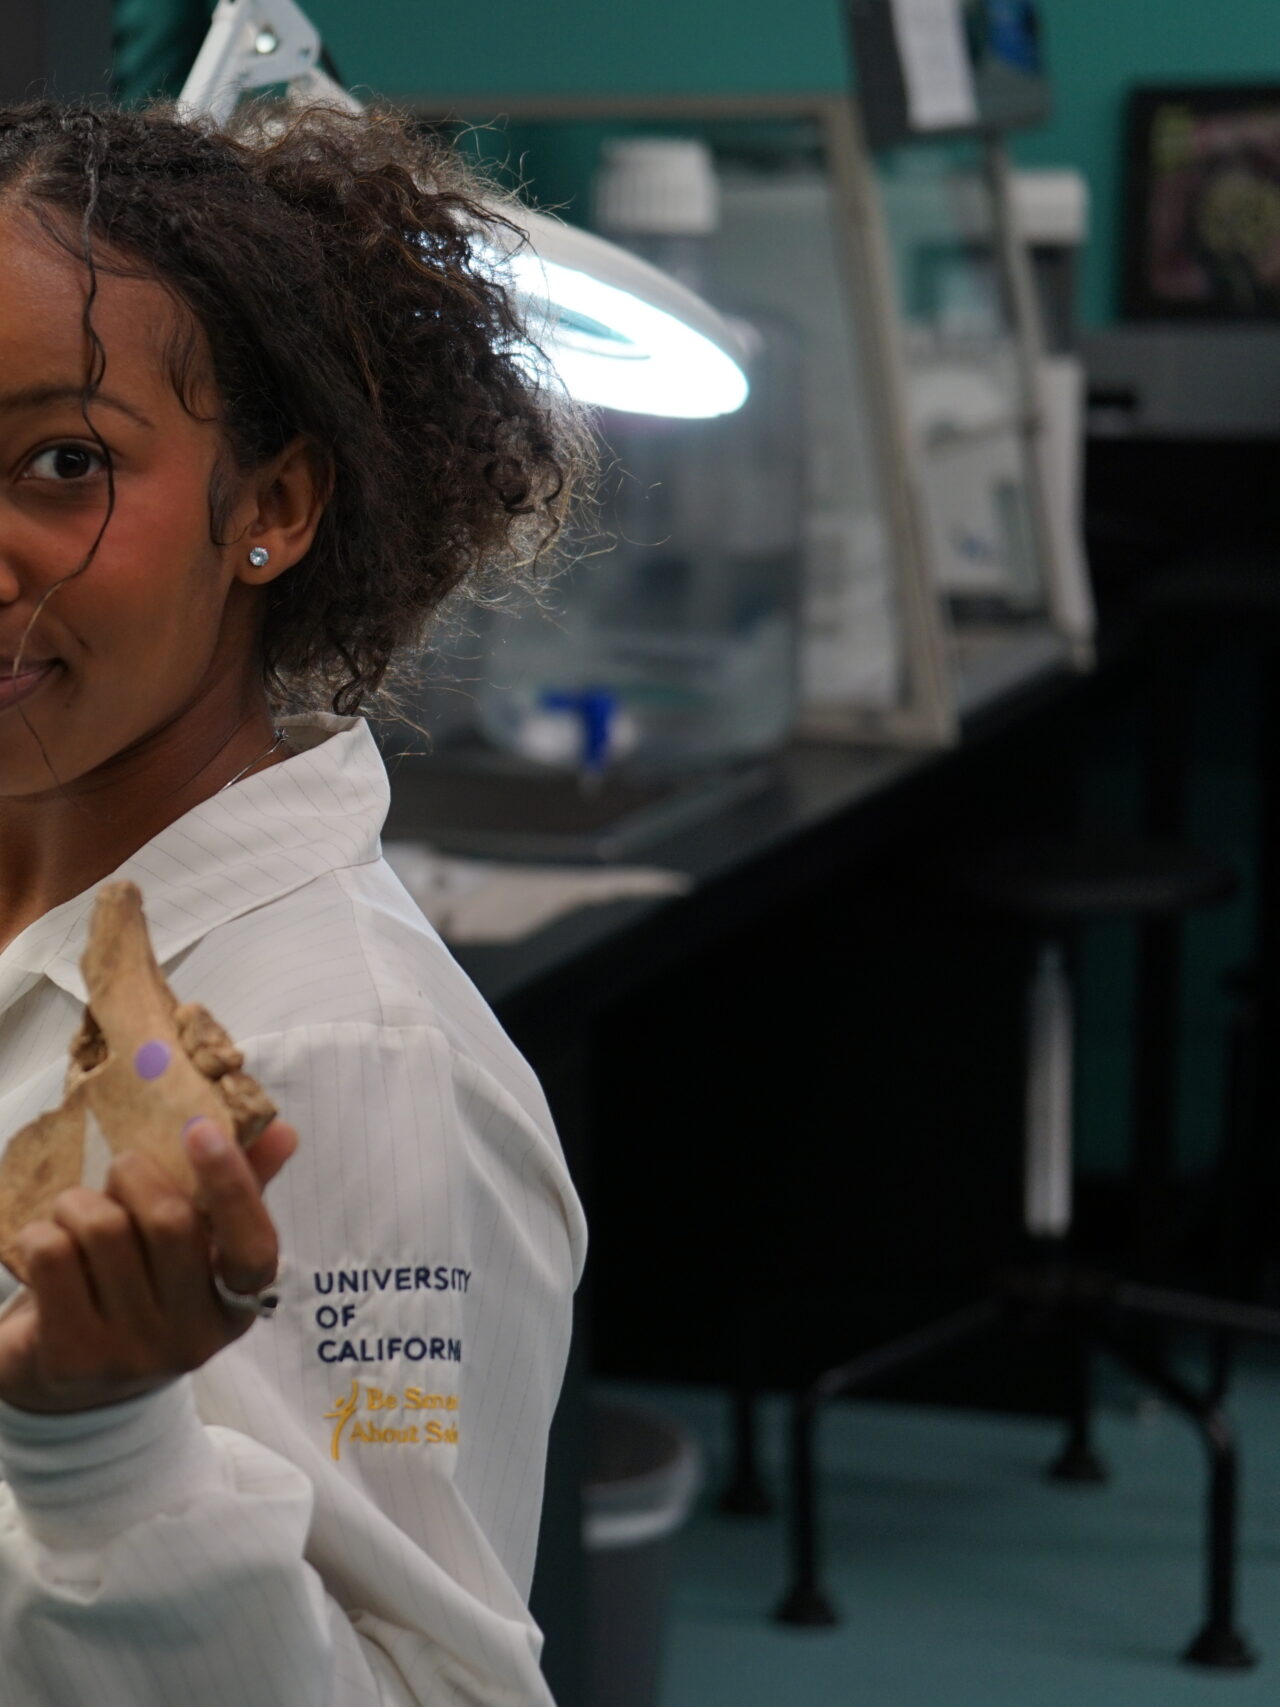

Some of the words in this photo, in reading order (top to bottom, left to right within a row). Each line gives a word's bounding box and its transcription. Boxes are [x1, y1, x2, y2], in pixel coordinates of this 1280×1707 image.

[314, 1266, 472, 1295] UNIVERSITY
[315, 1304, 356, 1329] OF
[366, 1387, 398, 1411] Be
[350, 1421, 420, 1443] About
